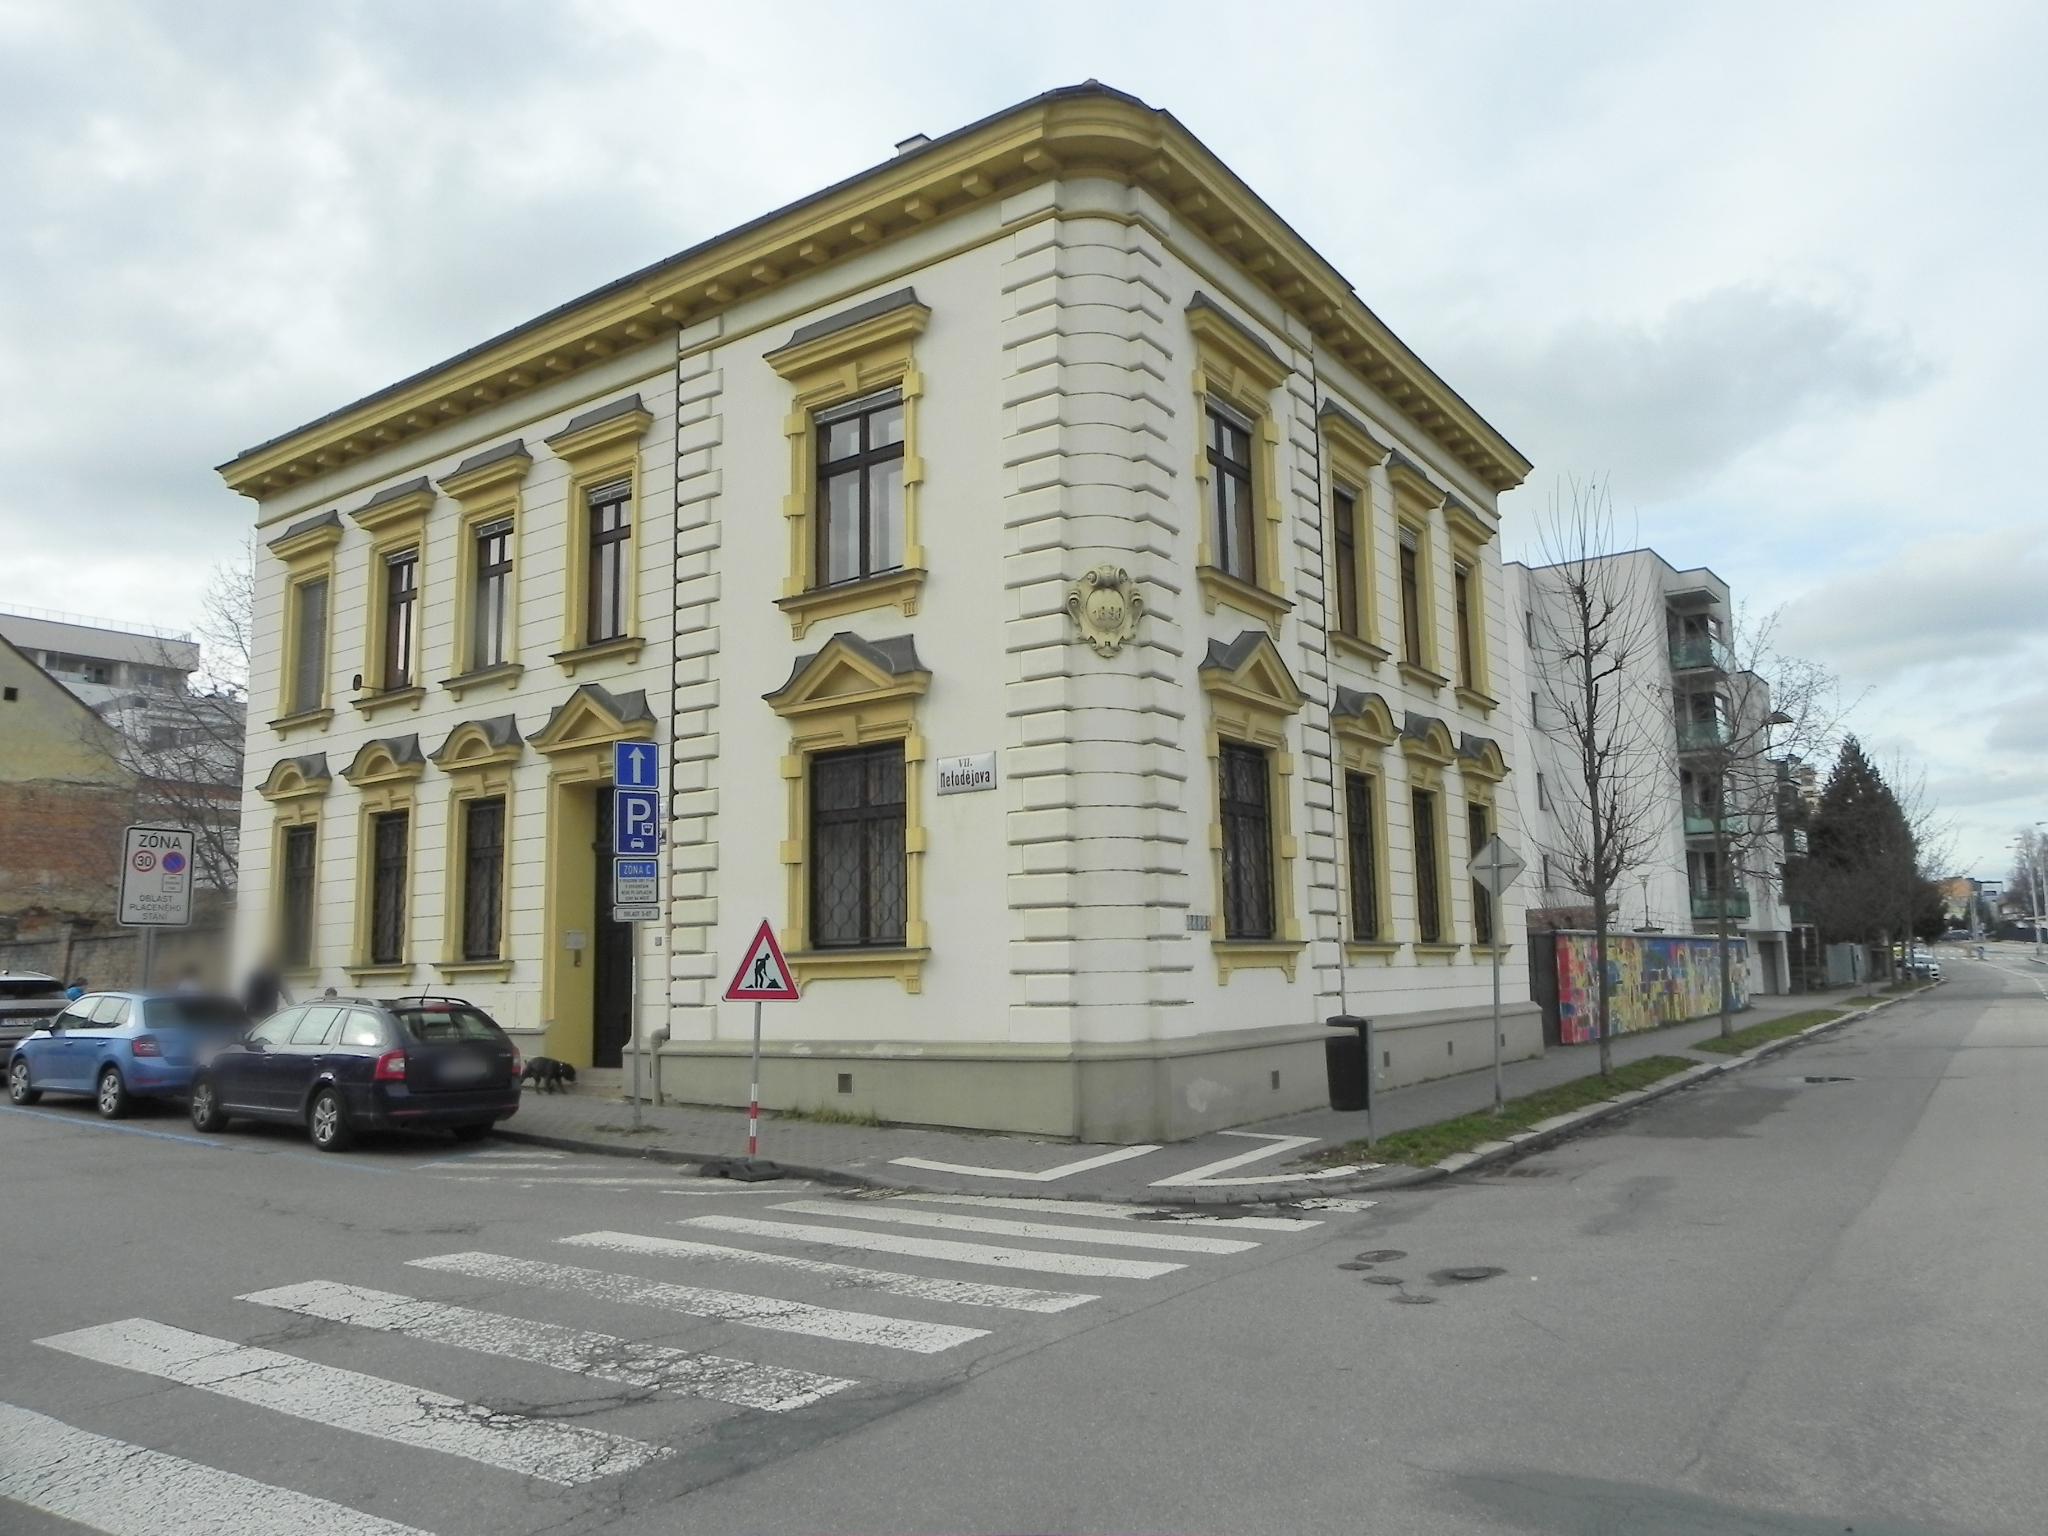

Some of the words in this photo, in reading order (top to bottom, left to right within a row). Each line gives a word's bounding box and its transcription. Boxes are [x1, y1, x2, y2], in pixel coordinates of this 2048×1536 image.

[958, 758, 973, 768] VII.
[940, 769, 990, 788] Metodějova
[627, 799, 651, 834] P
[138, 833, 182, 849] ZÓNA
[137, 855, 152, 867] 30
